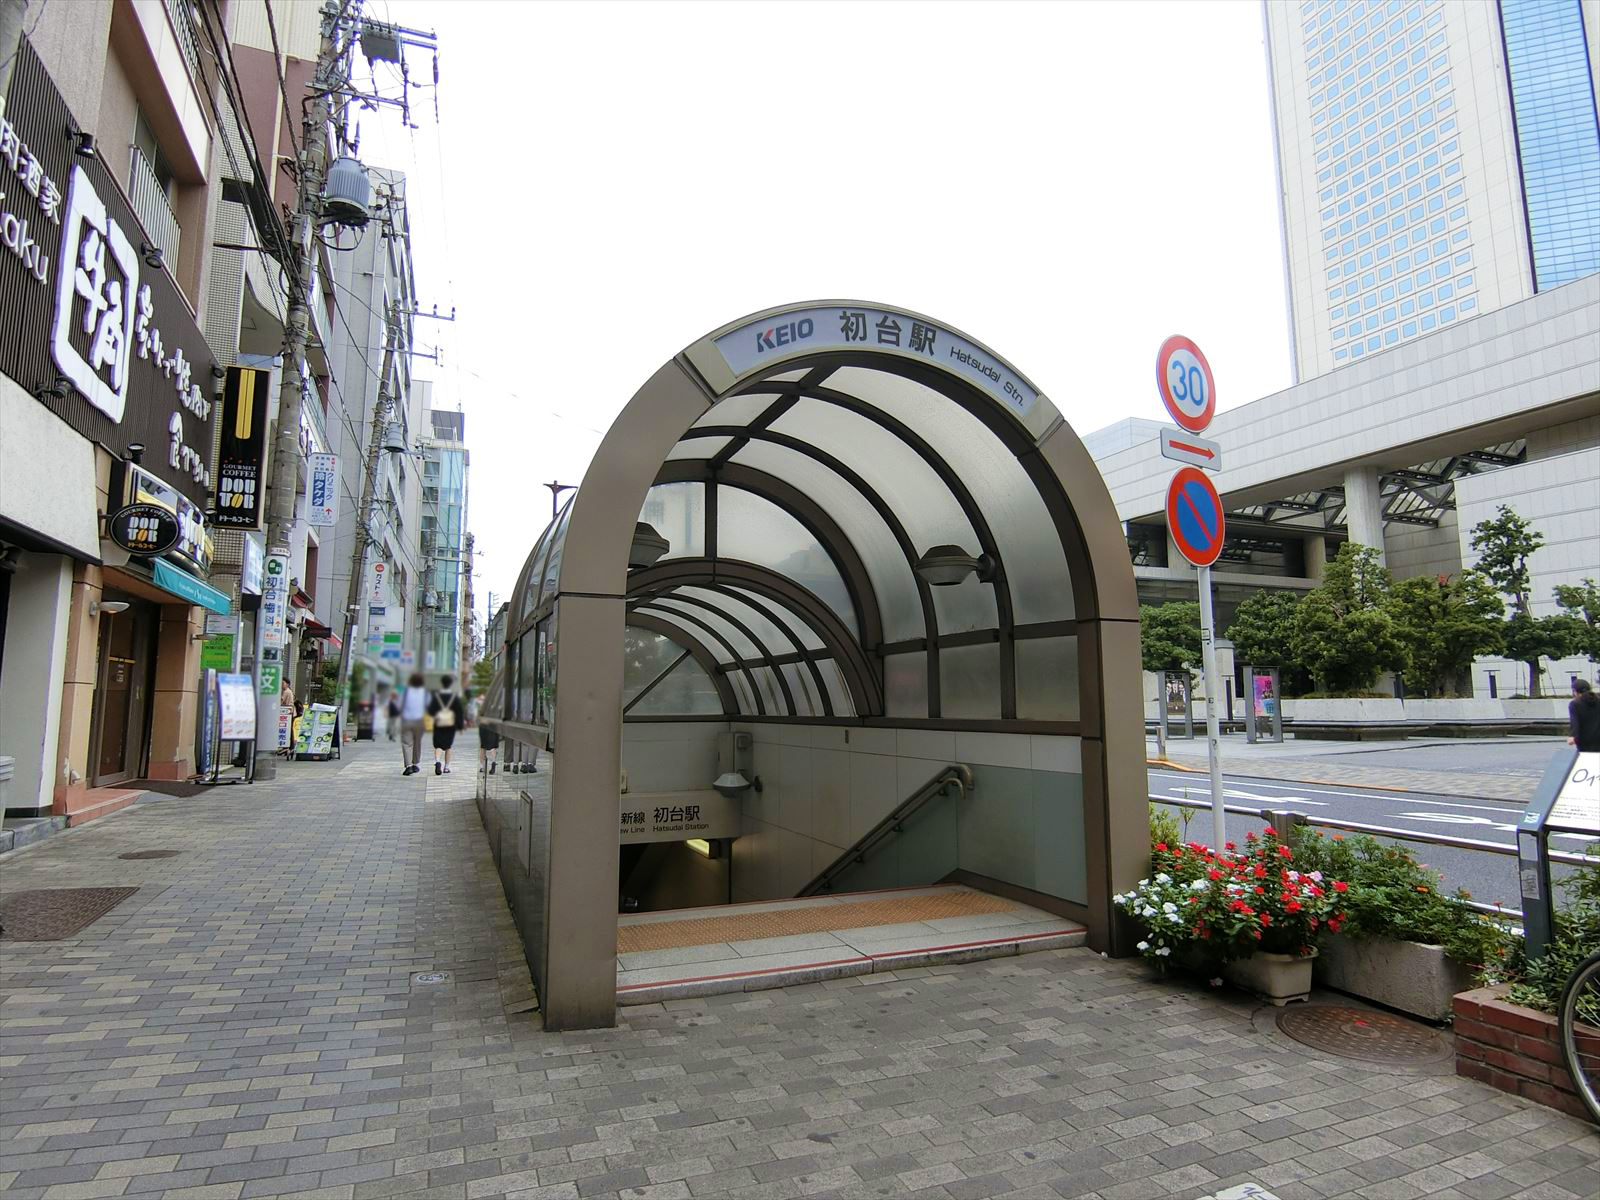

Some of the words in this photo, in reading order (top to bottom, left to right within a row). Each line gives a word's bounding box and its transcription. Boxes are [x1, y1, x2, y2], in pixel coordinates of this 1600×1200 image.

[75, 228, 123, 392] 牛角
[757, 318, 814, 353] KEIO
[839, 311, 937, 356] 初台駅
[950, 346, 1001, 383] Hatsudai
[1003, 382, 1025, 407] Stn.
[1172, 360, 1204, 406] 30
[222, 469, 256, 478] COFFEE
[653, 805, 700, 823] 初台駅
[653, 824, 683, 832] Hatsudai
[685, 823, 709, 831] Station
